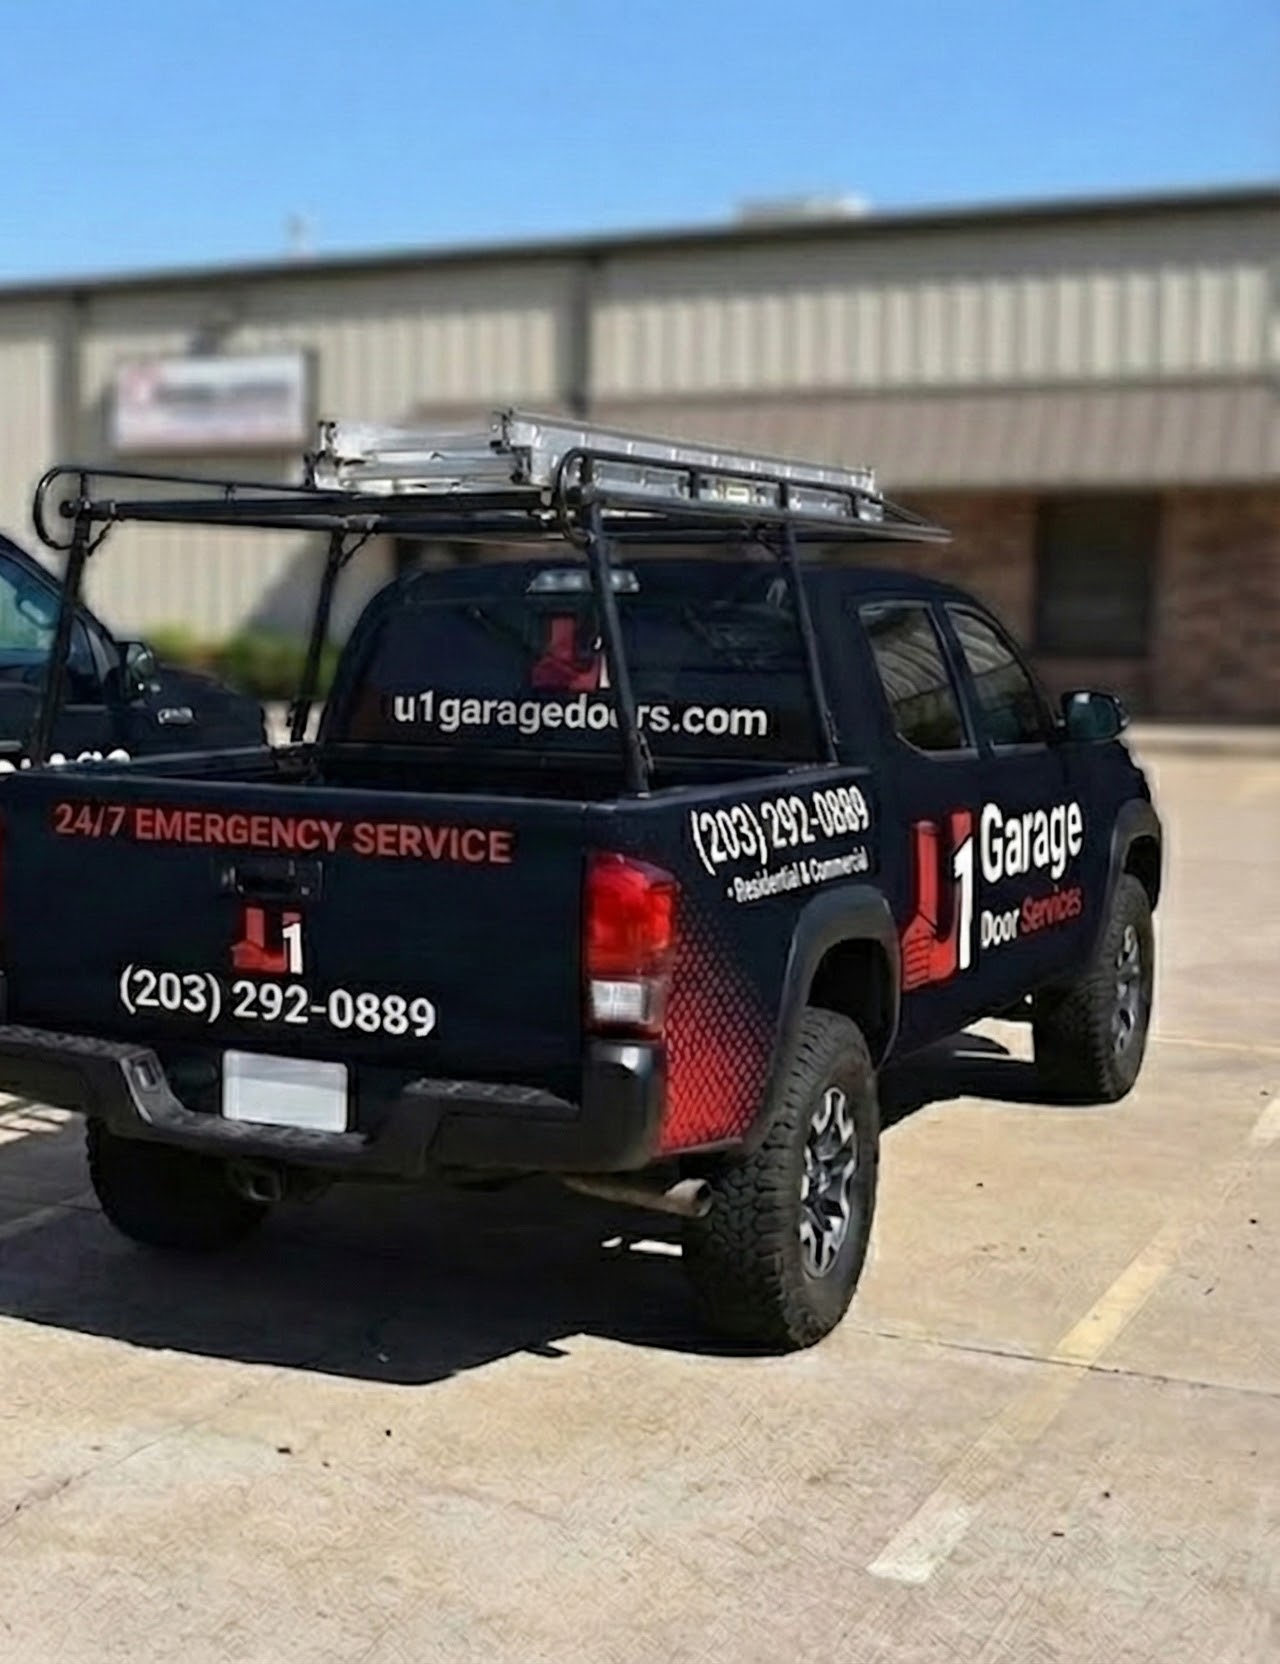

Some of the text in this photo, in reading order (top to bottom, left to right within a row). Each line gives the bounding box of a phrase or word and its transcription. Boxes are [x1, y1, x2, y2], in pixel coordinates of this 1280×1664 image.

[54, 803, 514, 863] 24/7 EMERGENCY SERVICE
[691, 784, 870, 877] (203) 292-0889
[980, 802, 1083, 884] Garage
[733, 868, 802, 904] Residential
[980, 884, 1083, 949] Door Services
[120, 963, 437, 1037] (203) 292-0889
